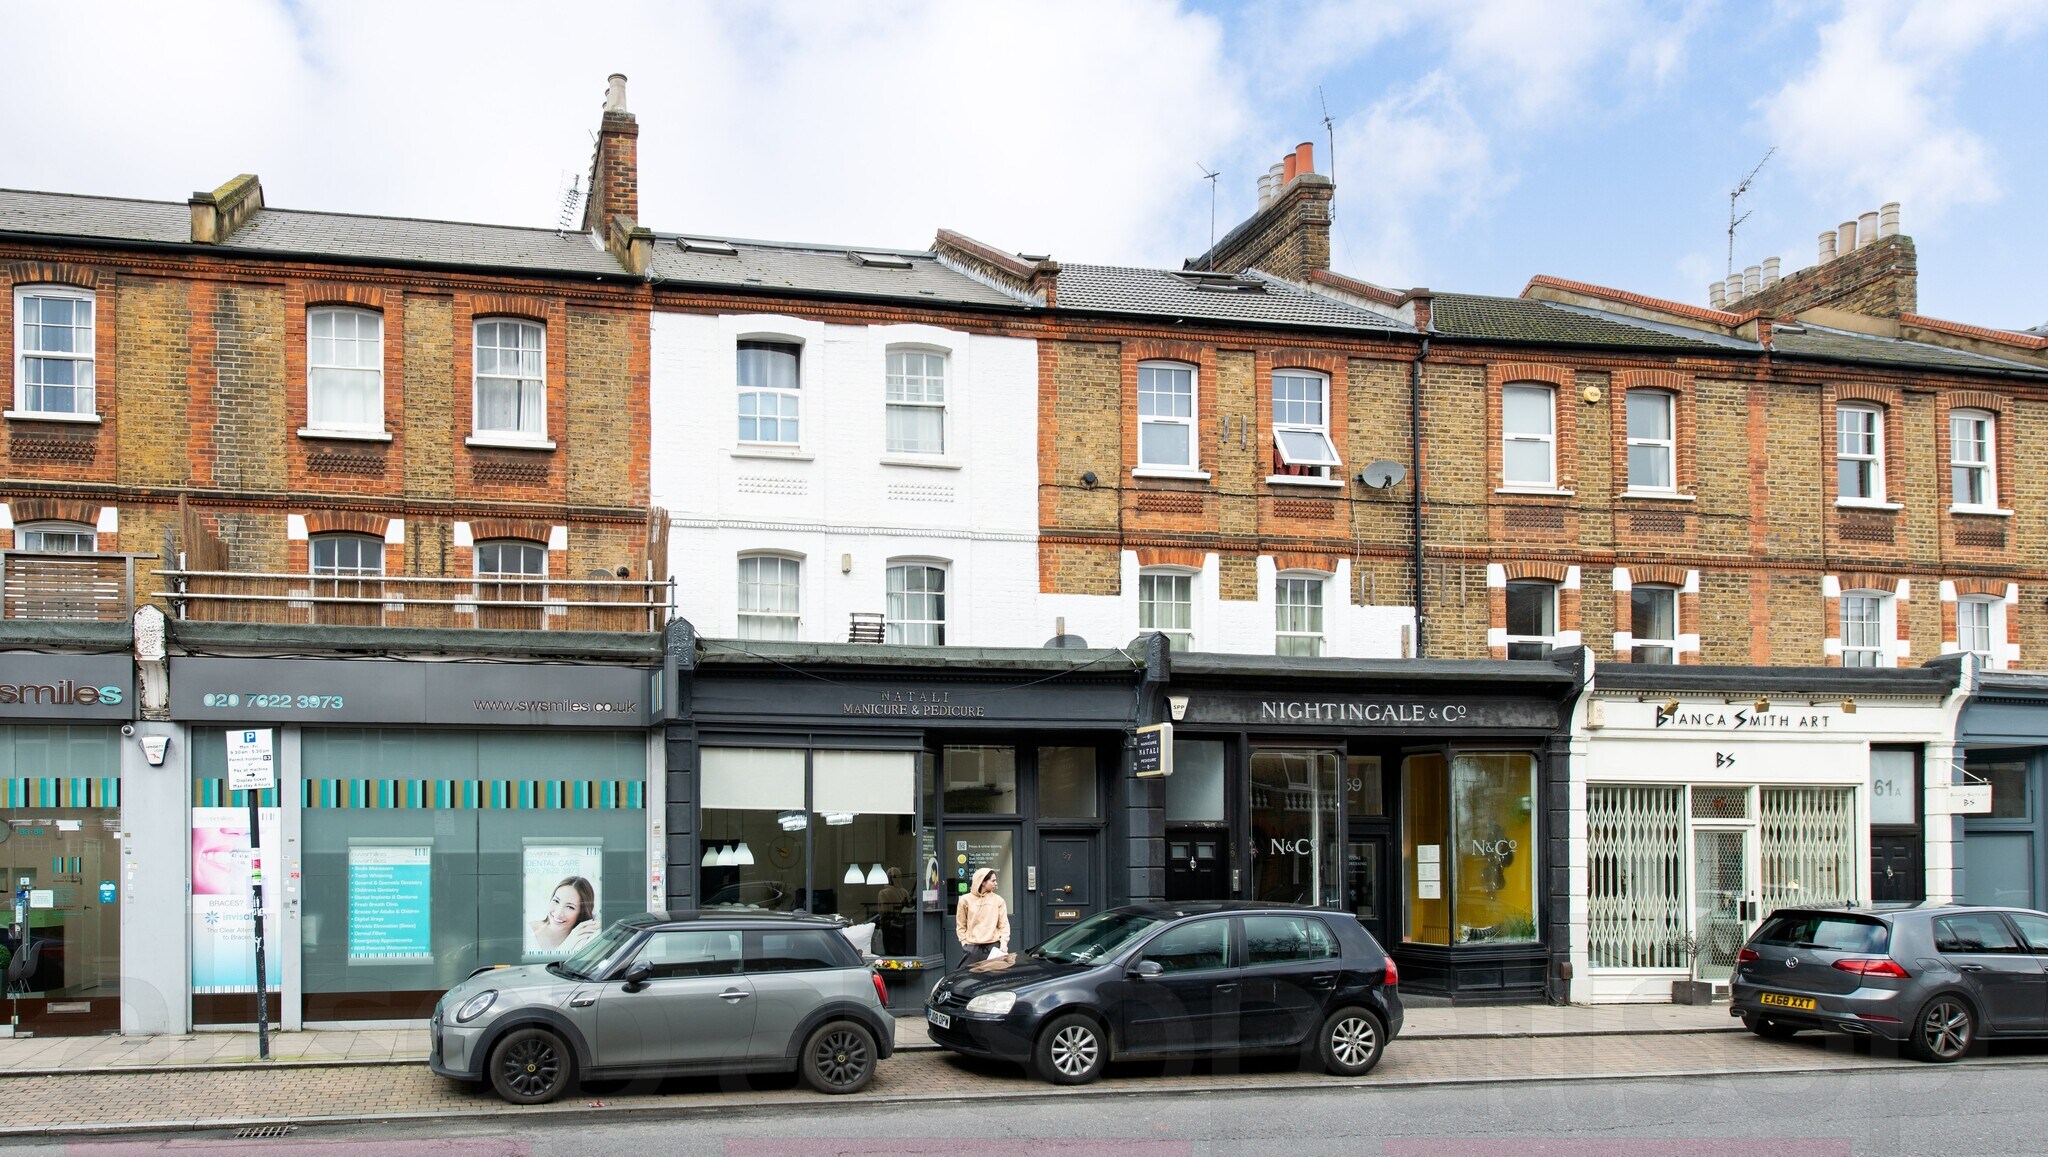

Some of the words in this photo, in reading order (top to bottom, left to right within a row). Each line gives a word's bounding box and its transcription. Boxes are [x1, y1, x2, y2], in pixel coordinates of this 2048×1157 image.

[0, 680, 123, 705] smiles
[881, 691, 949, 703] NATALI
[203, 693, 239, 707] 020
[244, 693, 292, 708] 7622
[296, 695, 343, 709] 3973
[473, 699, 637, 713] www.swsmiles.co.uk
[843, 703, 908, 715] MANICURE
[911, 705, 920, 715] &
[923, 705, 985, 717] PEDICURE
[1262, 702, 1425, 721] NIGHTINGALE
[1428, 707, 1438, 719] &
[1734, 708, 1789, 729] SMITH
[1799, 715, 1830, 728] ART
[1139, 747, 1159, 755] NATALI
[1716, 751, 1736, 769] BS
[209, 900, 244, 908] BRACES?
[1764, 994, 1789, 1006] EA68
[1791, 997, 1811, 1009] XXT
